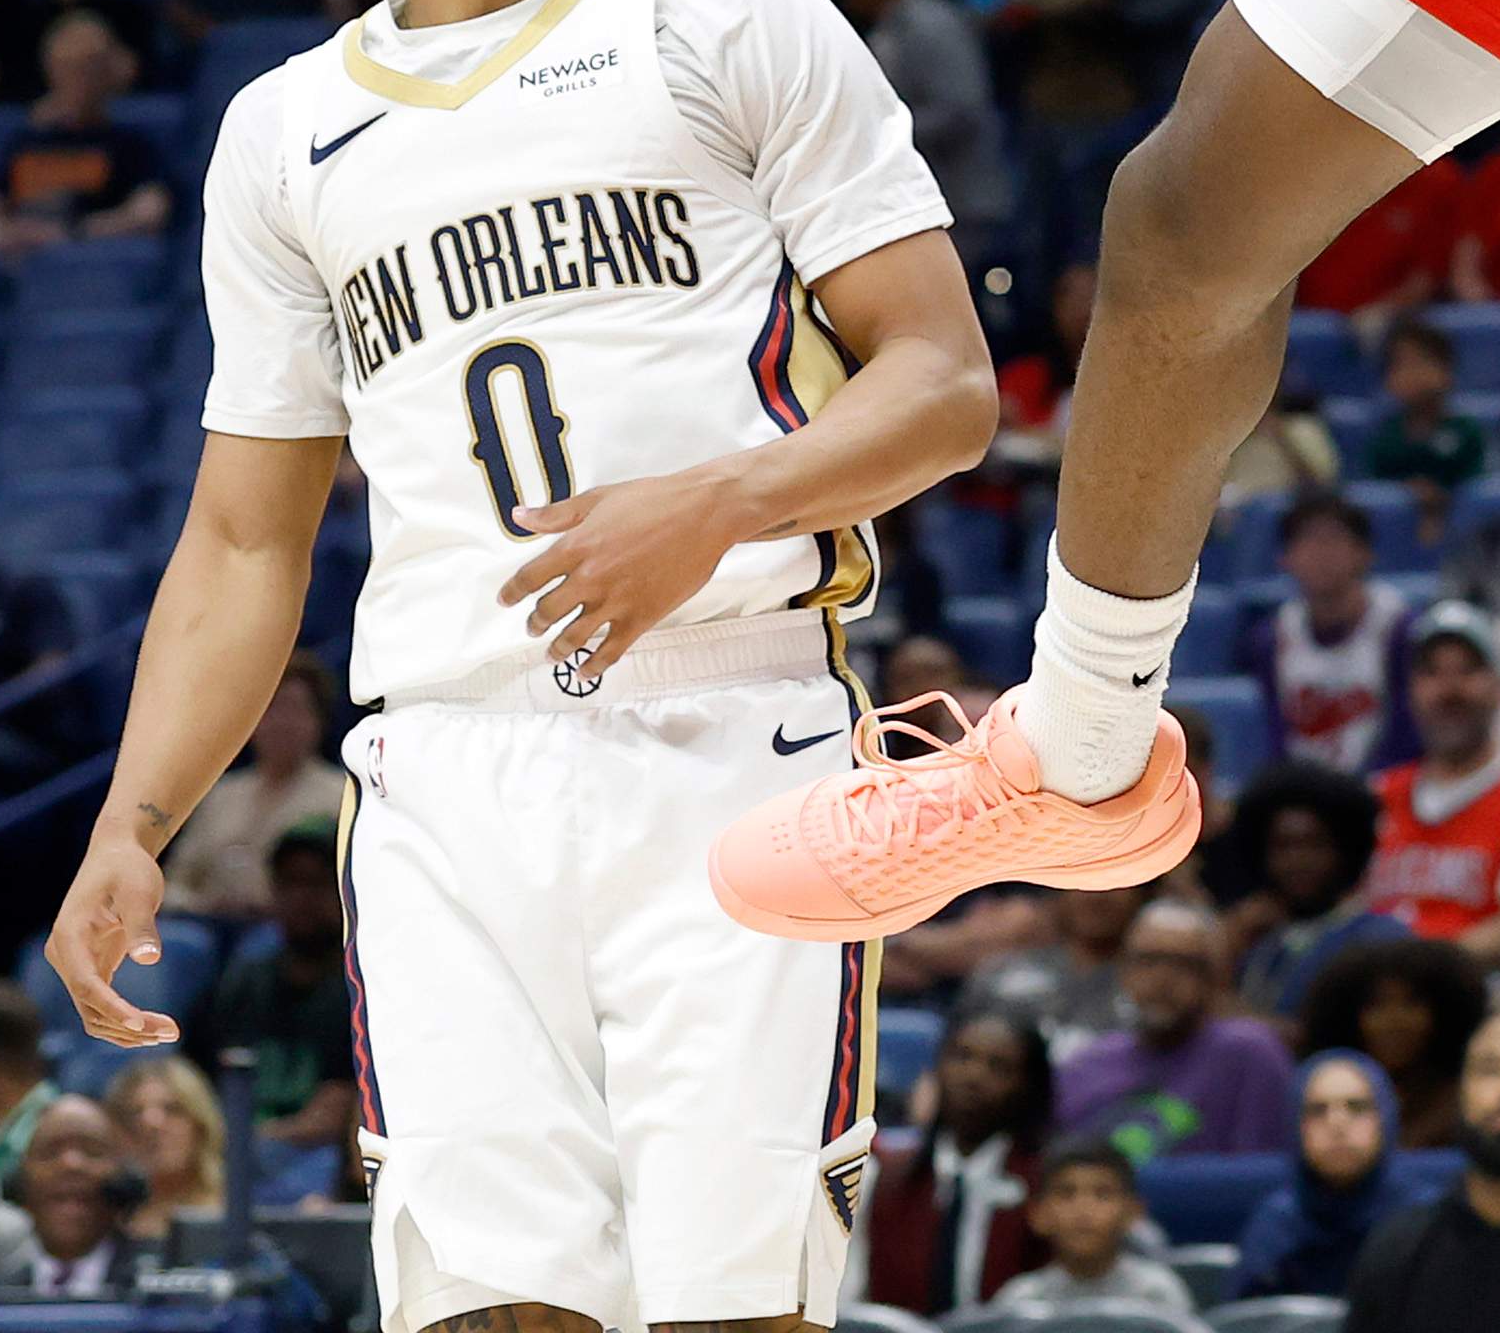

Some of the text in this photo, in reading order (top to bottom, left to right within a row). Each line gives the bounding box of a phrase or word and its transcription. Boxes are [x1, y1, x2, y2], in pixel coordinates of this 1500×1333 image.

[519, 48, 619, 89] NEWAGE
[543, 77, 597, 98] GRILLS
[429, 186, 701, 323] ORLEANS
[461, 335, 576, 544] 0
